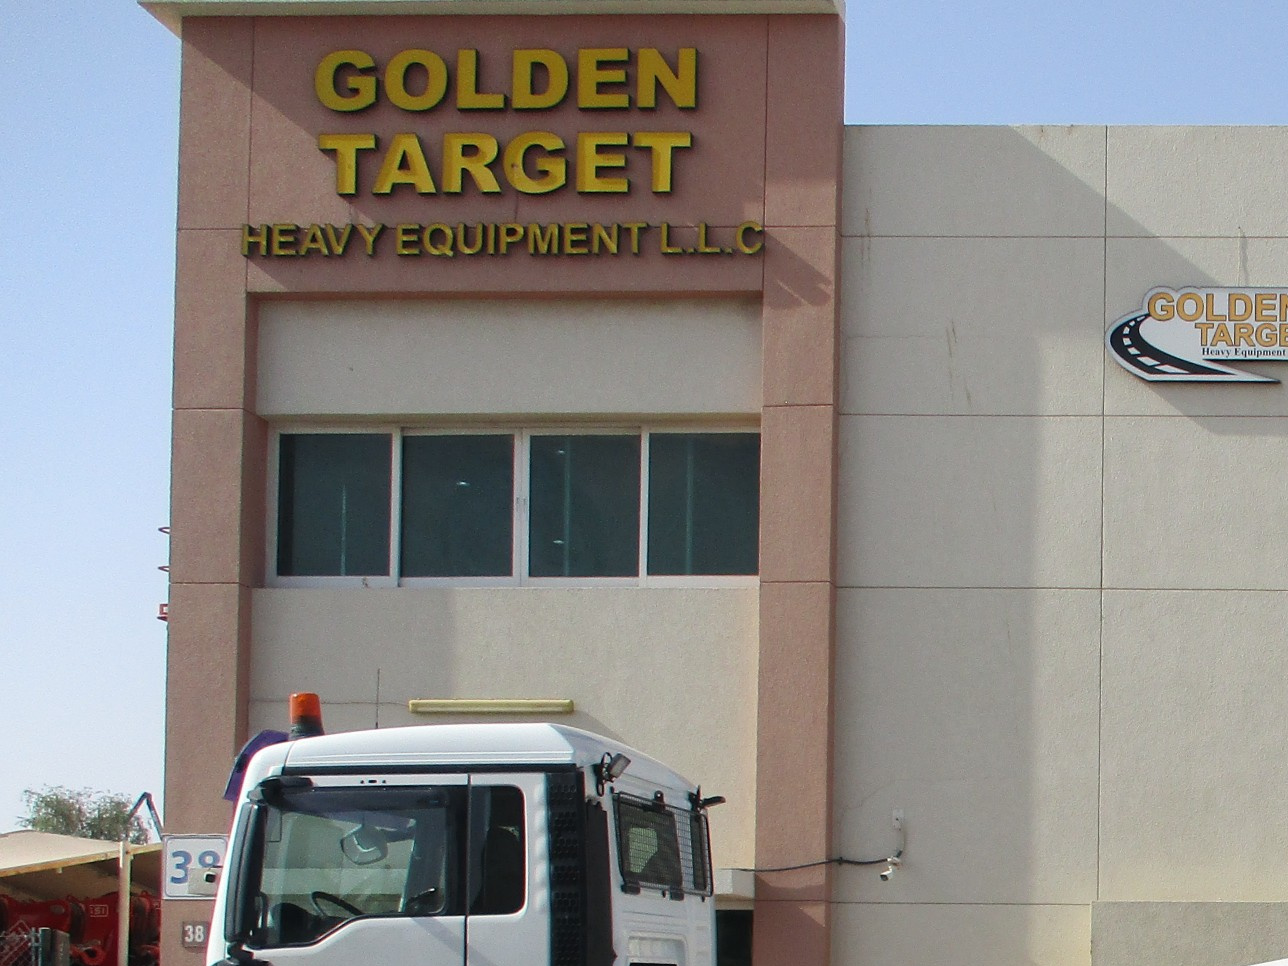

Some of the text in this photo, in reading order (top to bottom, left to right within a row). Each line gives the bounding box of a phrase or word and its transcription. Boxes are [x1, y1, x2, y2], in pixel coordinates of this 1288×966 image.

[314, 48, 698, 111] GOLDEN
[318, 131, 693, 196] TARGET
[240, 219, 765, 258] HEAVY EQUIPMENT L.L.C
[1202, 347, 1232, 358] Heavy
[1234, 347, 1287, 358] Equipment
[184, 925, 205, 942] 38
